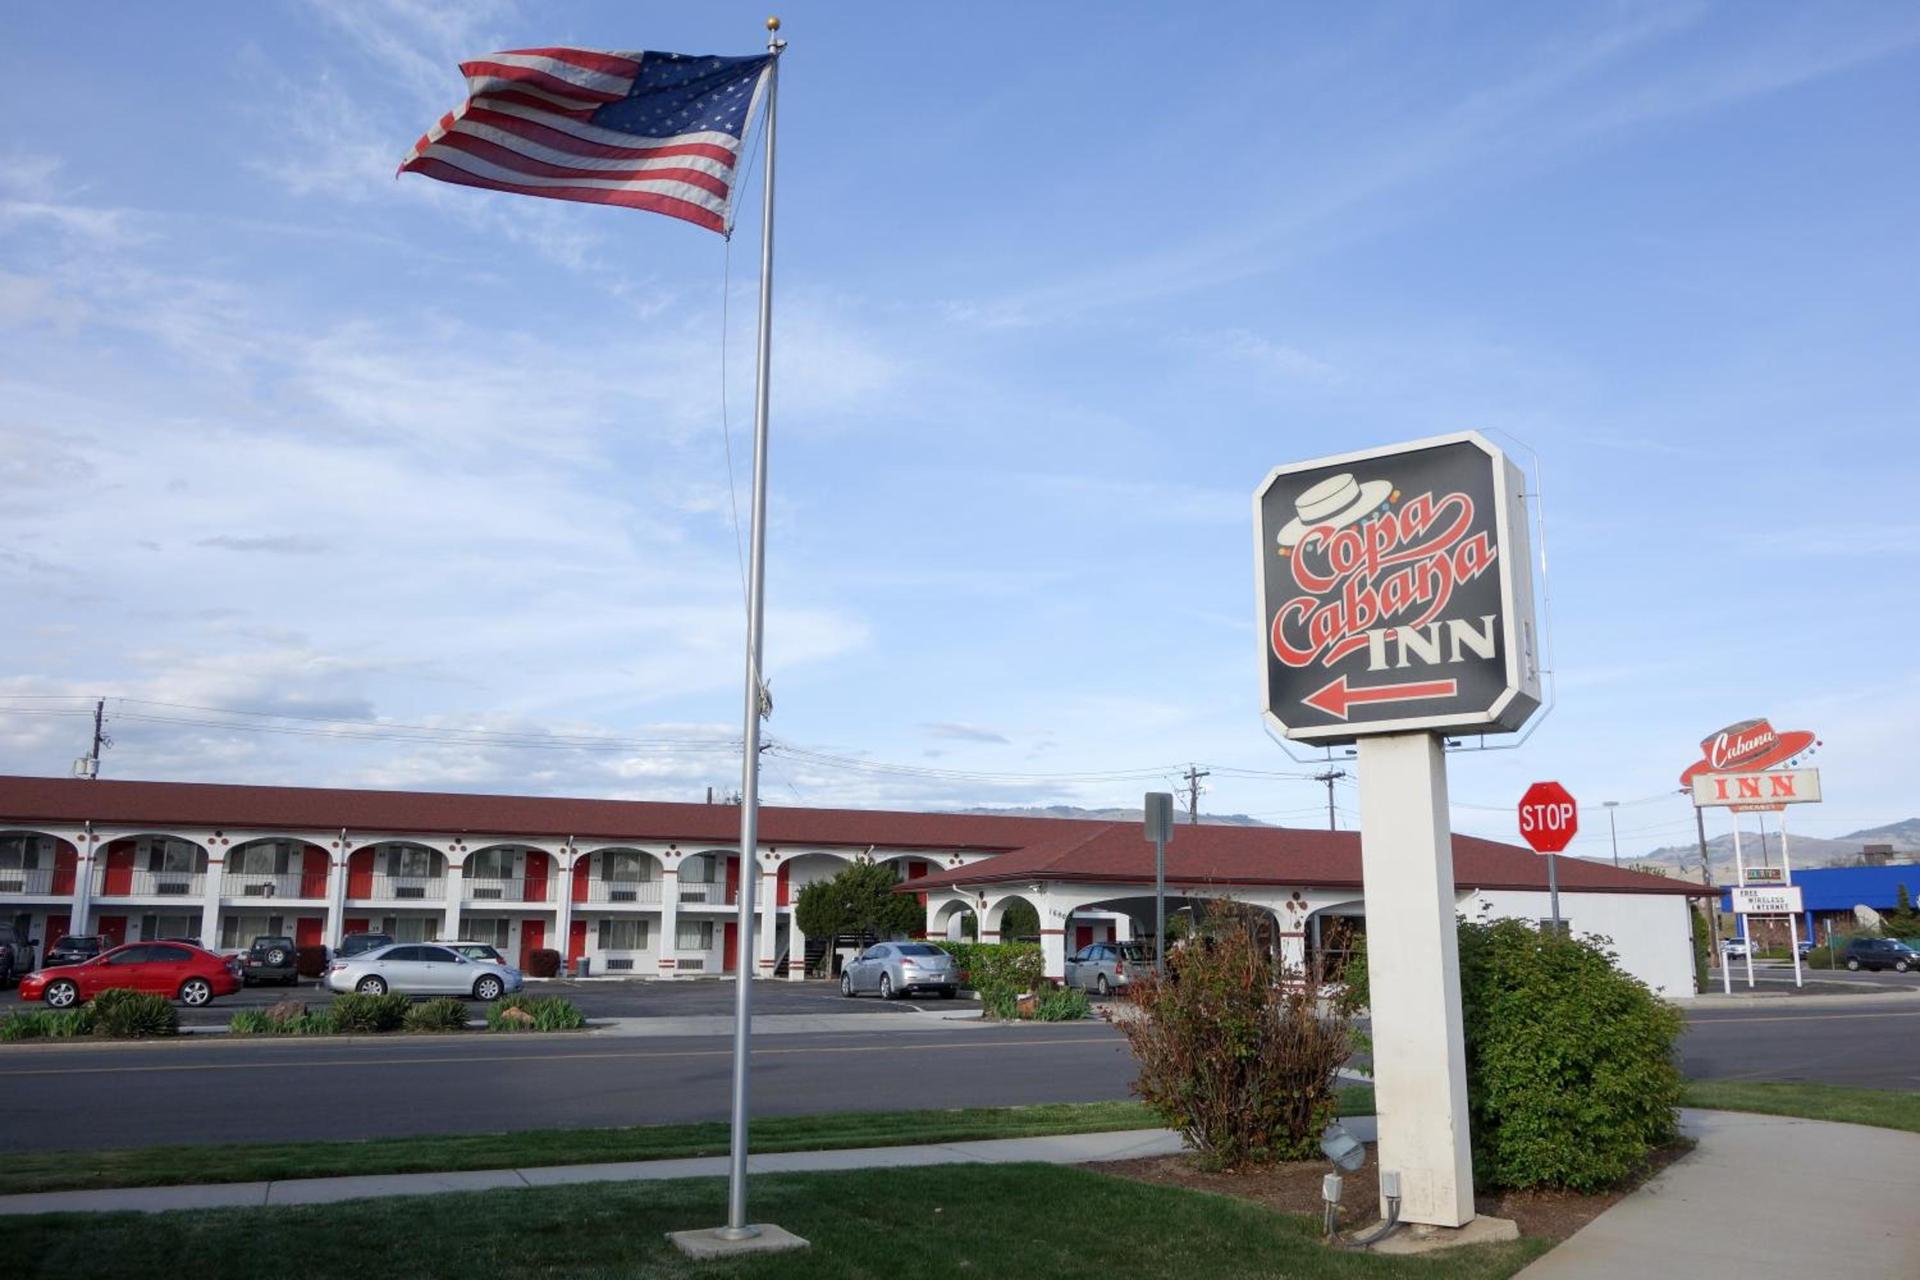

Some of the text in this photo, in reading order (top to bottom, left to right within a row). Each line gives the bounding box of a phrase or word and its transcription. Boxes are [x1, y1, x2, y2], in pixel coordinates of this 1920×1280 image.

[1291, 491, 1475, 595] Copa
[1271, 530, 1498, 668] Cabana
[1364, 614, 1498, 672] INN
[1711, 732, 1774, 769] Cabana
[1714, 775, 1796, 799] INN
[1522, 803, 1573, 832] STOP
[1748, 896, 1785, 904] WIRELESS
[1751, 903, 1789, 911] INTERNET
